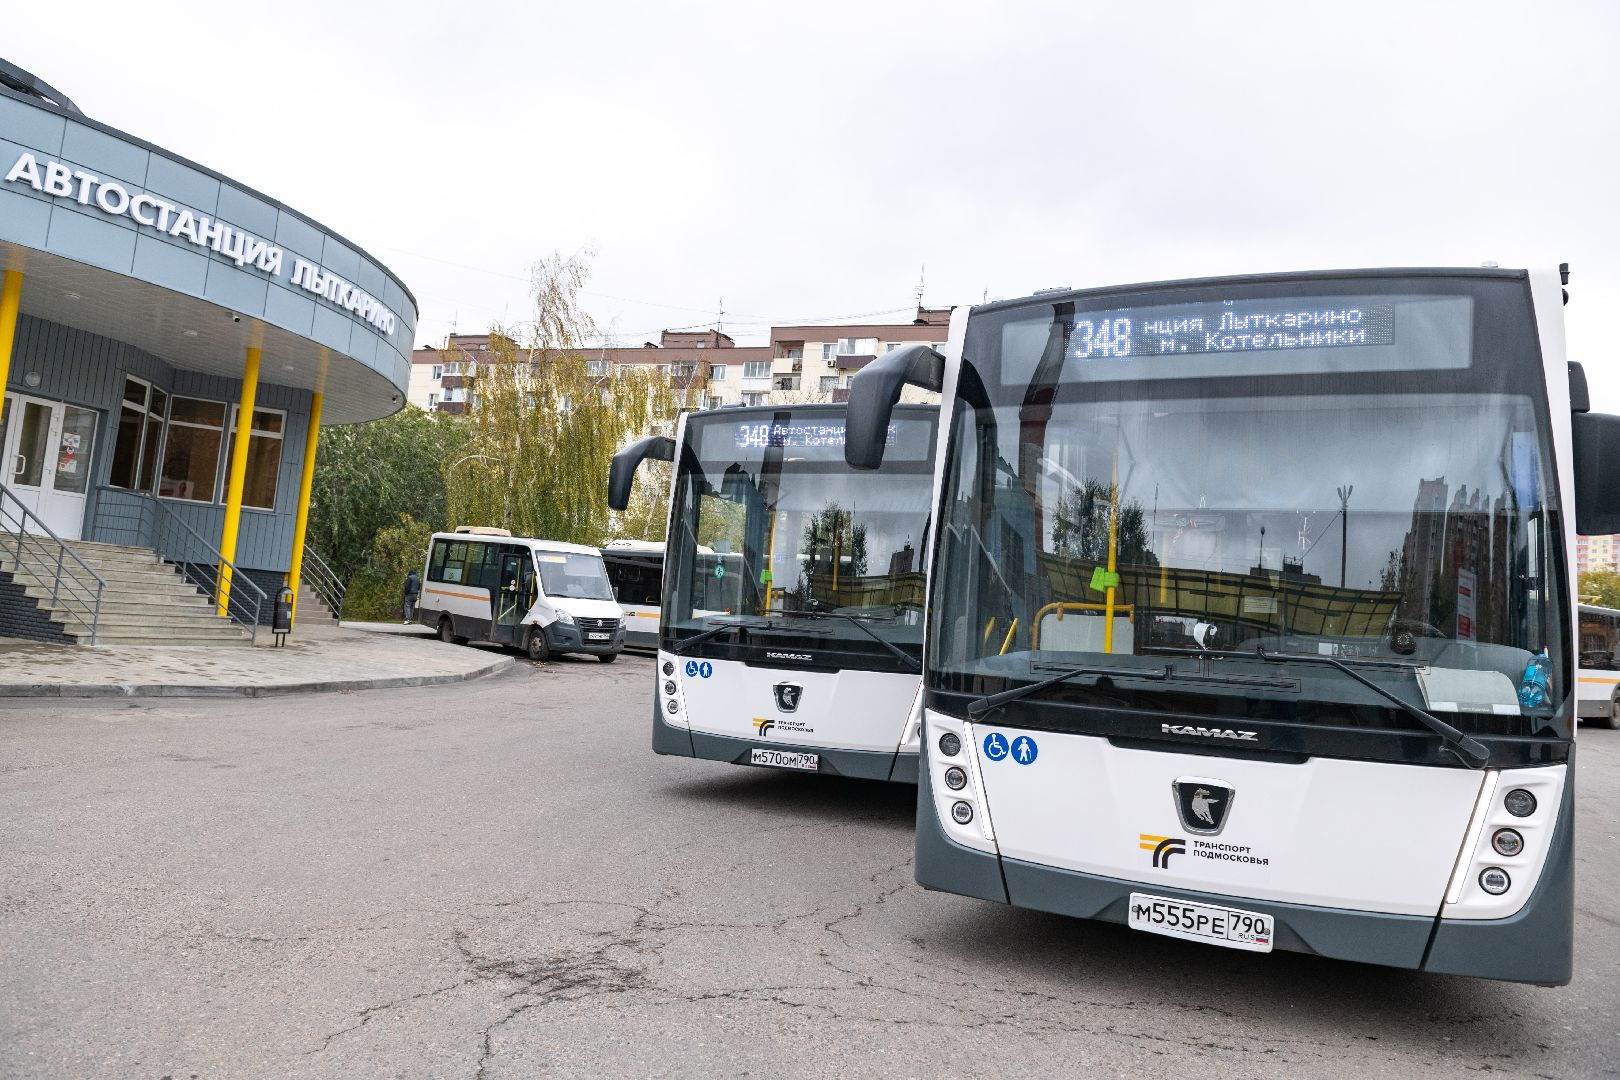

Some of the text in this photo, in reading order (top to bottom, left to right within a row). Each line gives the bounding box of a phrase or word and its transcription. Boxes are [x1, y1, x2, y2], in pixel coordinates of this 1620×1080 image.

[5, 152, 395, 336] АВТОСТАНЦИЯ ЛЫТКАРИНО
[1219, 309, 1363, 331] Лыткарино
[1074, 318, 1131, 358] 348
[1159, 330, 1365, 352] м. Котельники
[739, 425, 769, 448] 348
[773, 425, 846, 436] Автостанци
[766, 652, 813, 661] KAMAZ
[1161, 723, 1259, 742] KAMAZ
[798, 754, 815, 765] 790
[1193, 840, 1252, 854] ТРАНСПОРТ
[1193, 849, 1269, 866] ПОДМОСКОВЬЯ
[1136, 902, 1265, 935] М555РЕ 790
[1238, 932, 1255, 941] RUS
